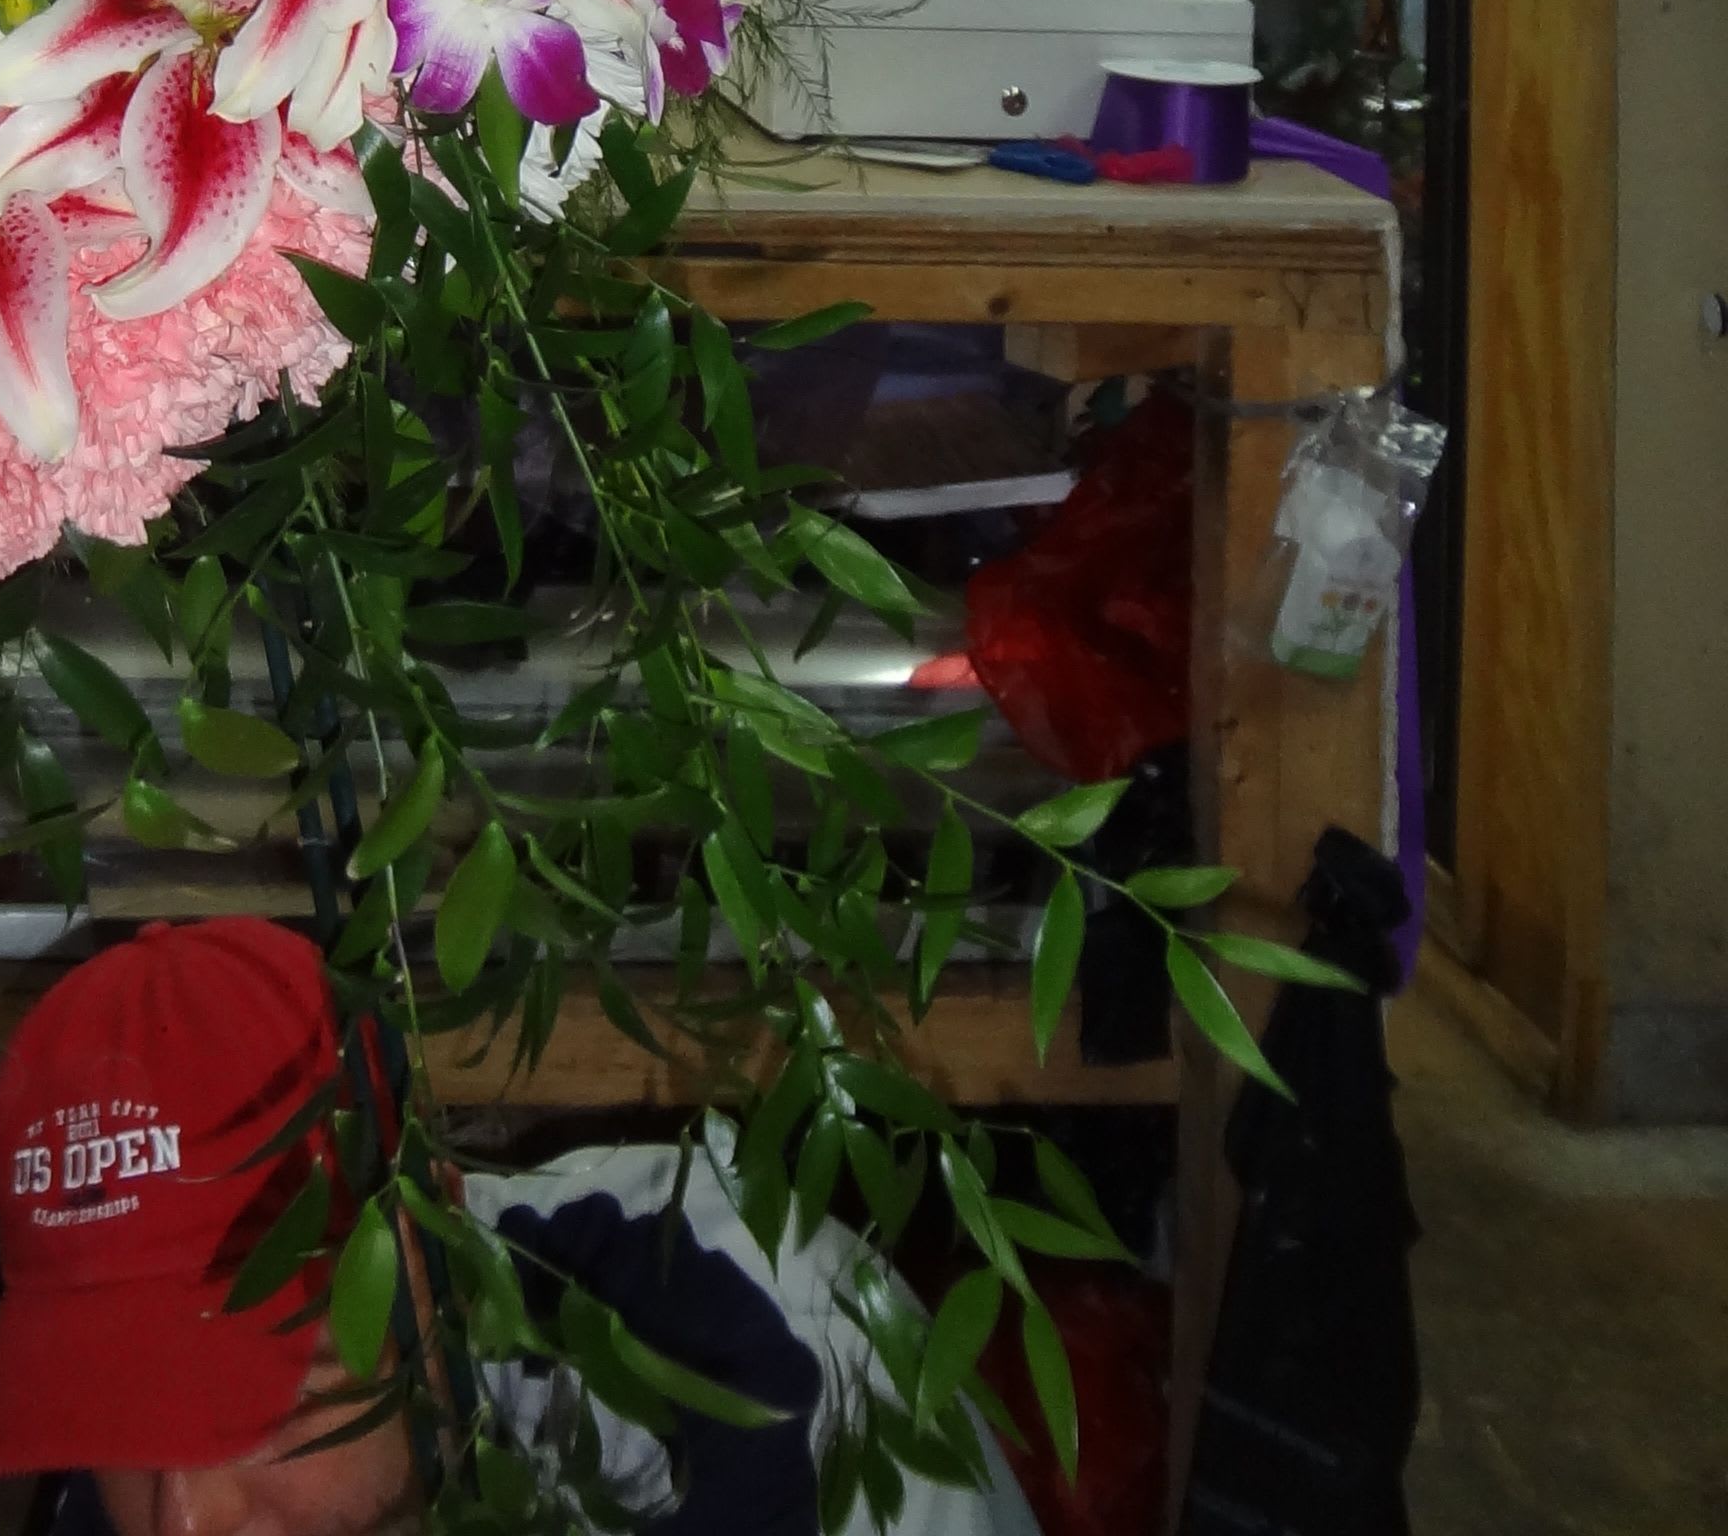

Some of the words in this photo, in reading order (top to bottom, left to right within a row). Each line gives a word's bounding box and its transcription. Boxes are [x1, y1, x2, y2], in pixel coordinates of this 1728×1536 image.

[111, 1098, 159, 1120] CITY
[13, 1145, 52, 1196] US
[63, 1124, 181, 1190] OPEN
